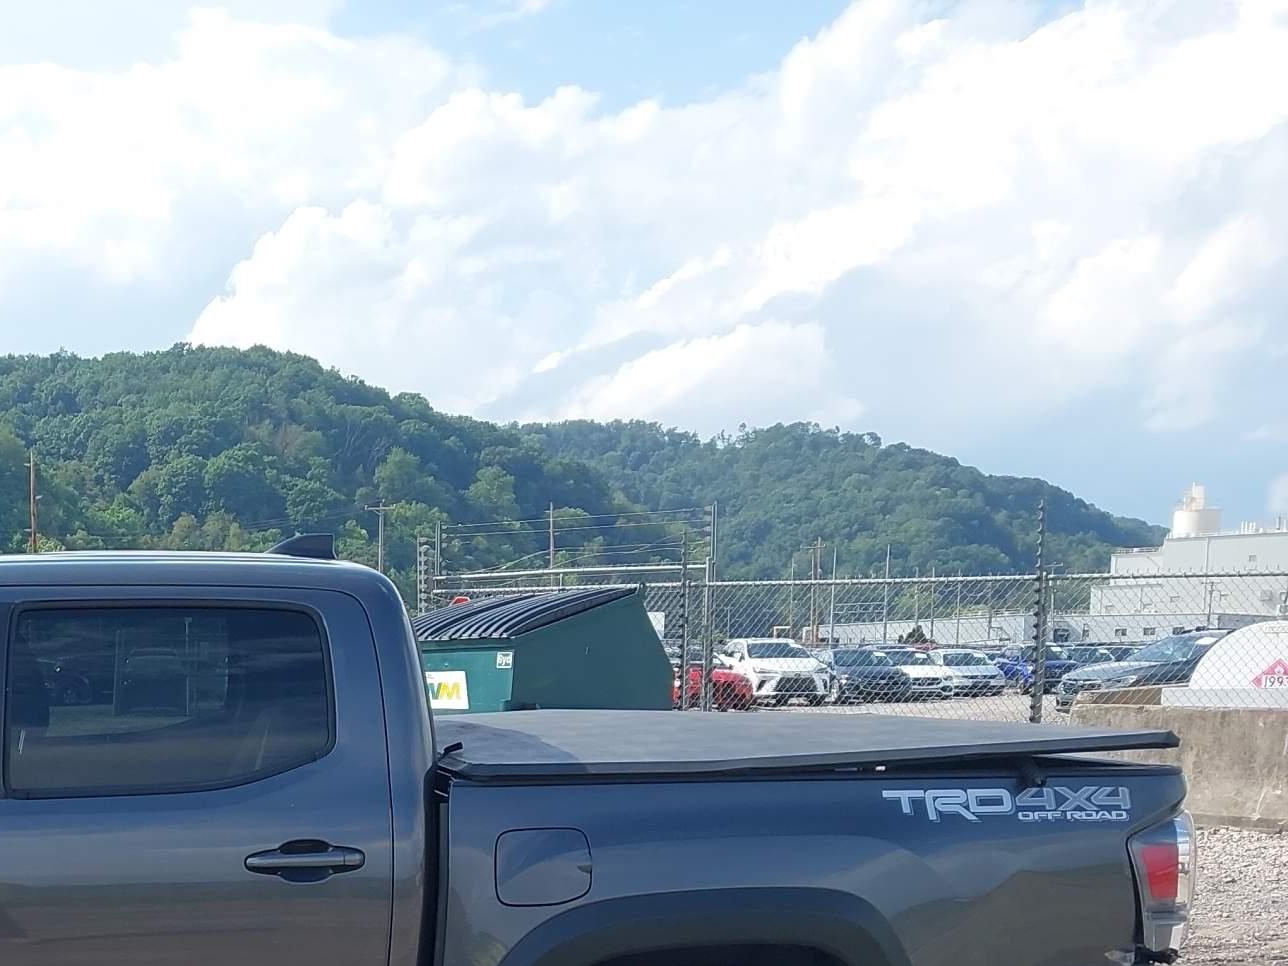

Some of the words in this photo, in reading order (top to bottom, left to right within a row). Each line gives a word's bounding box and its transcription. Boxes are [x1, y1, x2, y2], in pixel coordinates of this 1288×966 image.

[882, 789, 1013, 823] TRD
[1018, 811, 1063, 822] OFF
[1066, 811, 1129, 822] ROAD
